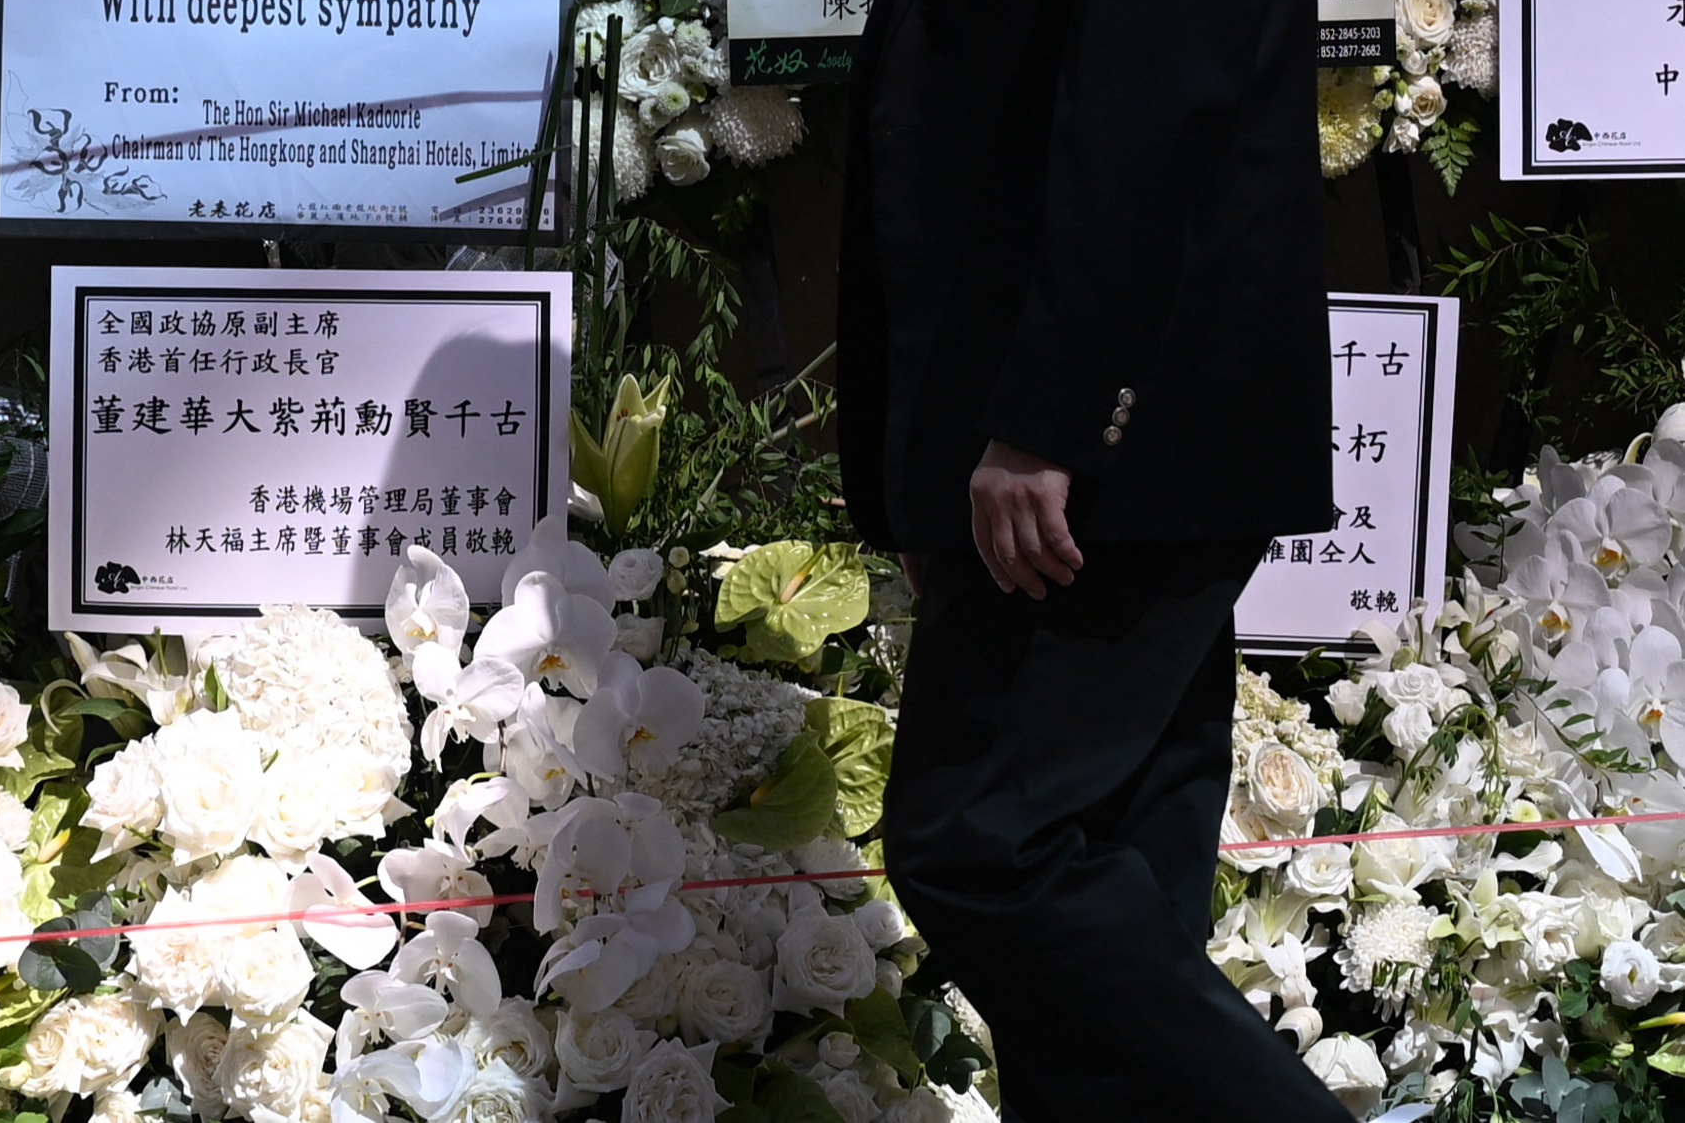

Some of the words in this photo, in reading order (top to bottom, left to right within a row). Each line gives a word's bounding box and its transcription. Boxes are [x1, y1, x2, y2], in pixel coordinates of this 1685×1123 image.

[1320, 26, 1381, 41] 852-2845-5203
[817, 47, 853, 73] Lovely
[1320, 44, 1381, 58] 852-2877-2682
[103, 82, 179, 104] From:
[1655, 63, 1679, 96] 中
[203, 99, 231, 125] The
[234, 100, 264, 126] Hon
[268, 101, 289, 126] Sir
[294, 101, 351, 127] Michael
[355, 103, 421, 130] Kadoorie
[112, 134, 183, 162] Chairman
[187, 135, 203, 161] of
[207, 135, 235, 162] The
[239, 136, 315, 166] Hongkong
[319, 138, 346, 164] and
[351, 139, 421, 169] Shanghai
[425, 140, 477, 170] Hotels,
[97, 309, 340, 338] 全國政協原副主席
[97, 347, 340, 377] 香港首任行政長官
[1333, 340, 1411, 377] 千古
[91, 395, 528, 439] 董建華大紫荊勳賢千古
[248, 484, 517, 517] 香港機場管理局董事會
[164, 525, 518, 558] 林天福主席暨董事會成員敬輓
[1350, 589, 1399, 613] 敬輓
